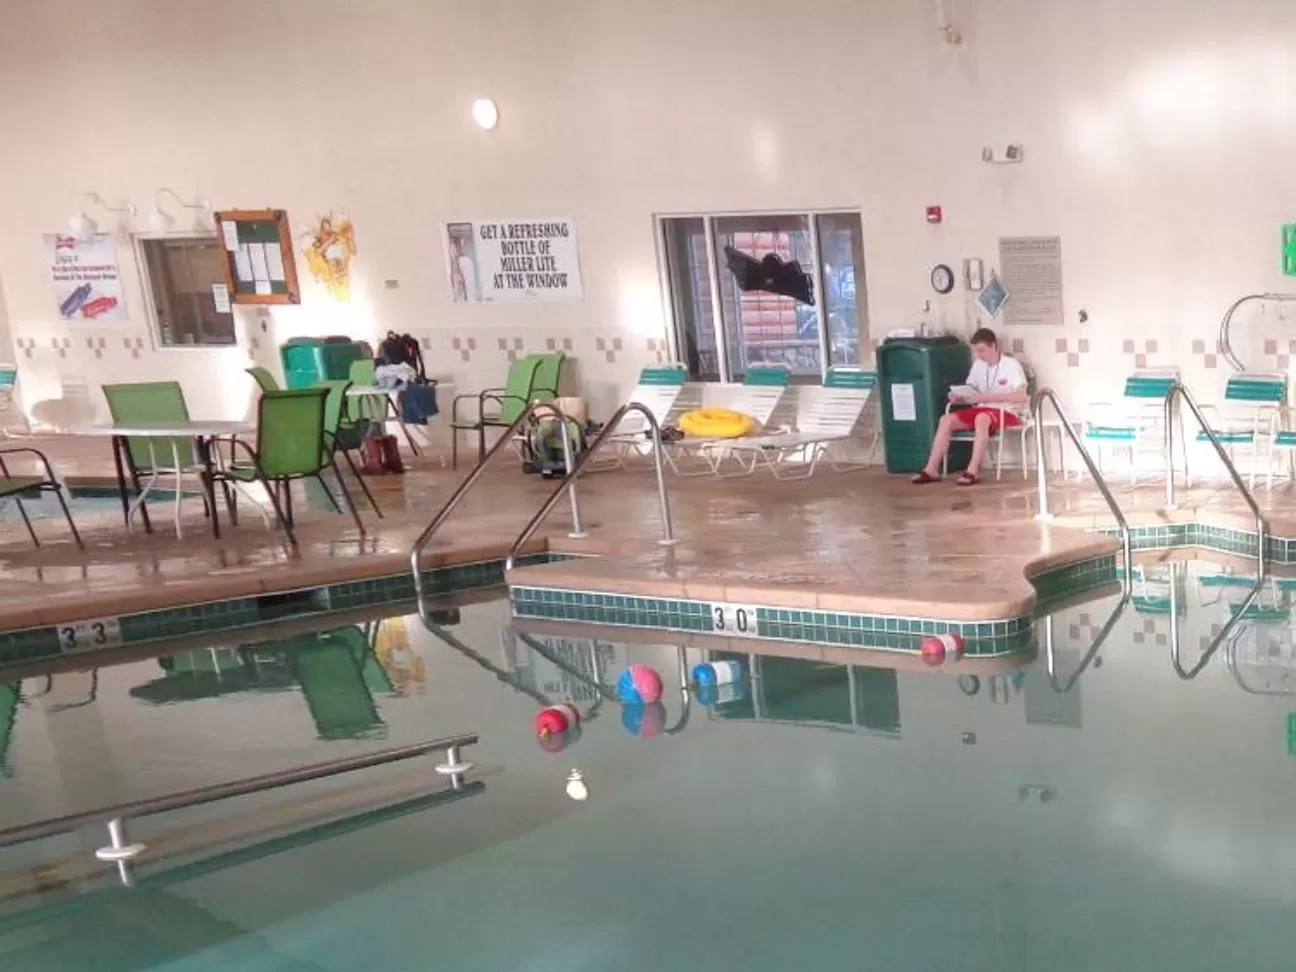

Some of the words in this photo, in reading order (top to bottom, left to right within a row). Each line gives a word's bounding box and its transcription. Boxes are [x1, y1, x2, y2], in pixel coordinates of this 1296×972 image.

[480, 224, 498, 240] GET
[499, 223, 508, 239] A
[508, 222, 570, 240] REFRESHING
[500, 240, 537, 256] BOTTLE
[537, 240, 551, 255] OF
[500, 256, 536, 272] MILLER
[536, 255, 558, 271] LITE
[494, 274, 504, 289] AT
[506, 273, 524, 289] THE
[527, 272, 568, 288] WINDOW
